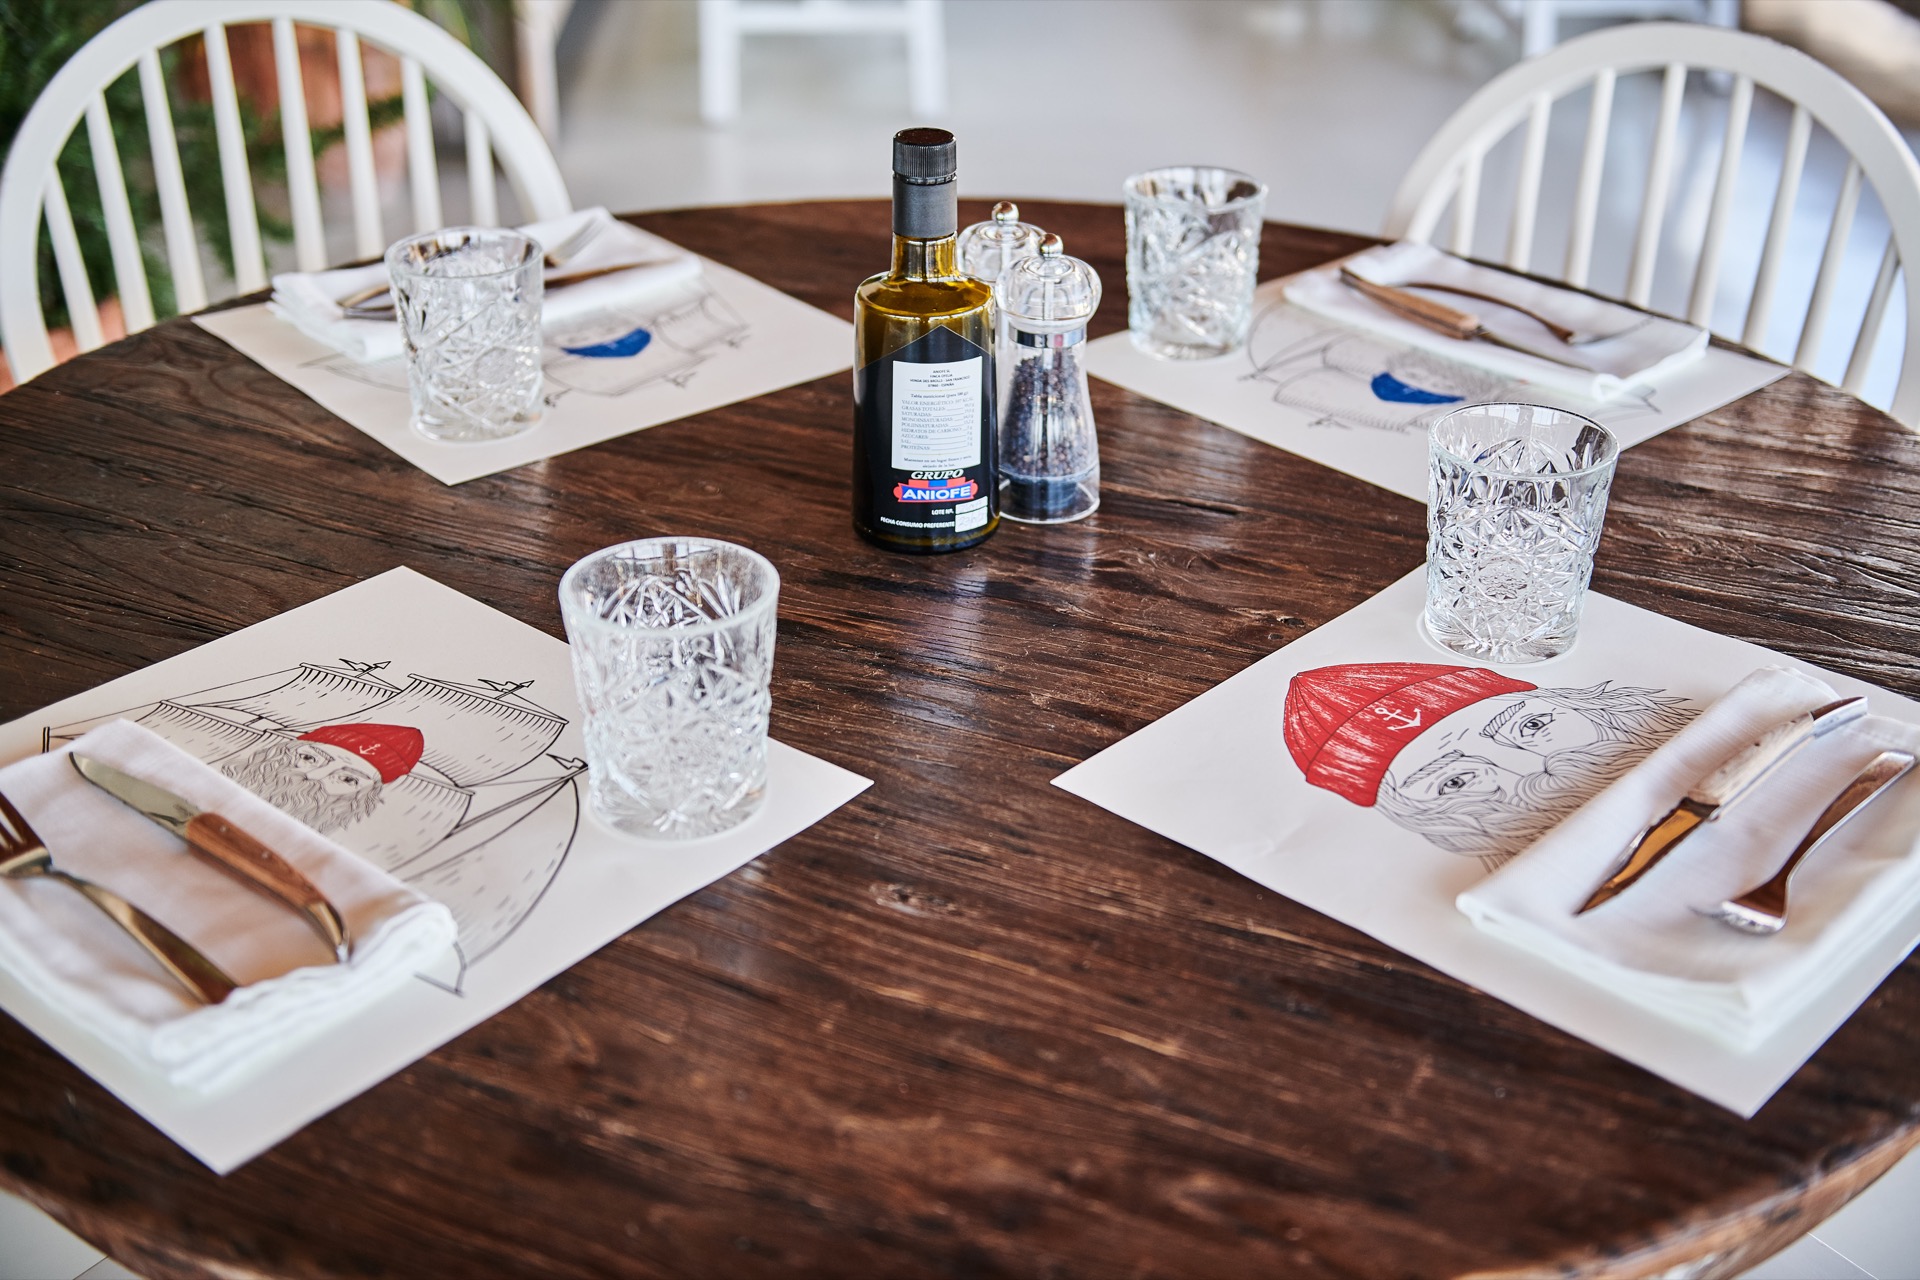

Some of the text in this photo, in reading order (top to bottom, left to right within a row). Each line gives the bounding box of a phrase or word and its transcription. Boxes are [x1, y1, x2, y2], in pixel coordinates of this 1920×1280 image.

[911, 468, 964, 480] GRUPO
[902, 485, 971, 500] ANIOFE
[880, 516, 896, 525] FECHA
[896, 520, 923, 528] CONSUMO
